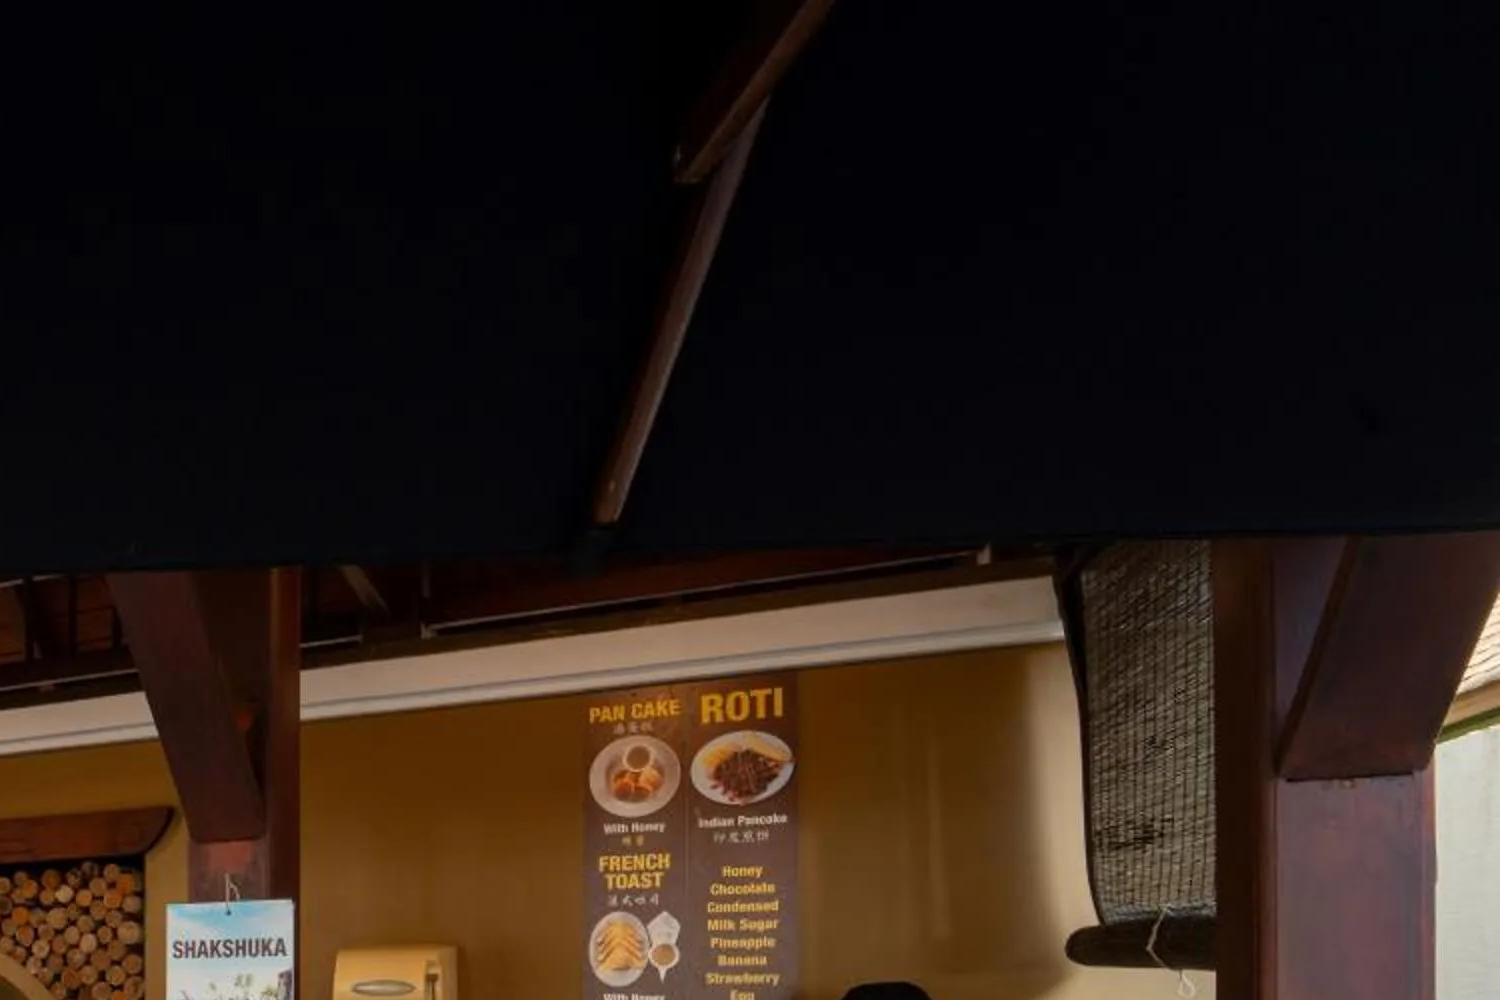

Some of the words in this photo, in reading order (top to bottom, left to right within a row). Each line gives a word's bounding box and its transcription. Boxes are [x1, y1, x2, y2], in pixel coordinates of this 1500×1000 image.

[589, 704, 626, 724] PAN
[631, 699, 681, 719] CAKE
[700, 687, 785, 724] ROTI
[698, 817, 735, 829] Indian
[738, 813, 788, 827] Pancake
[603, 823, 629, 835] With
[631, 822, 666, 834] Honey
[598, 853, 671, 873] FRENCH
[722, 866, 763, 878] Honey
[605, 871, 665, 891] TOAST
[710, 882, 776, 896] Chocolate
[707, 900, 779, 913] Condensed
[707, 918, 736, 931] Milk
[739, 918, 779, 932] Sugar
[172, 937, 288, 960] SHAKSHUKA
[710, 936, 776, 950] Pineapple
[718, 955, 768, 966] Banana
[705, 972, 780, 987] Strawberry
